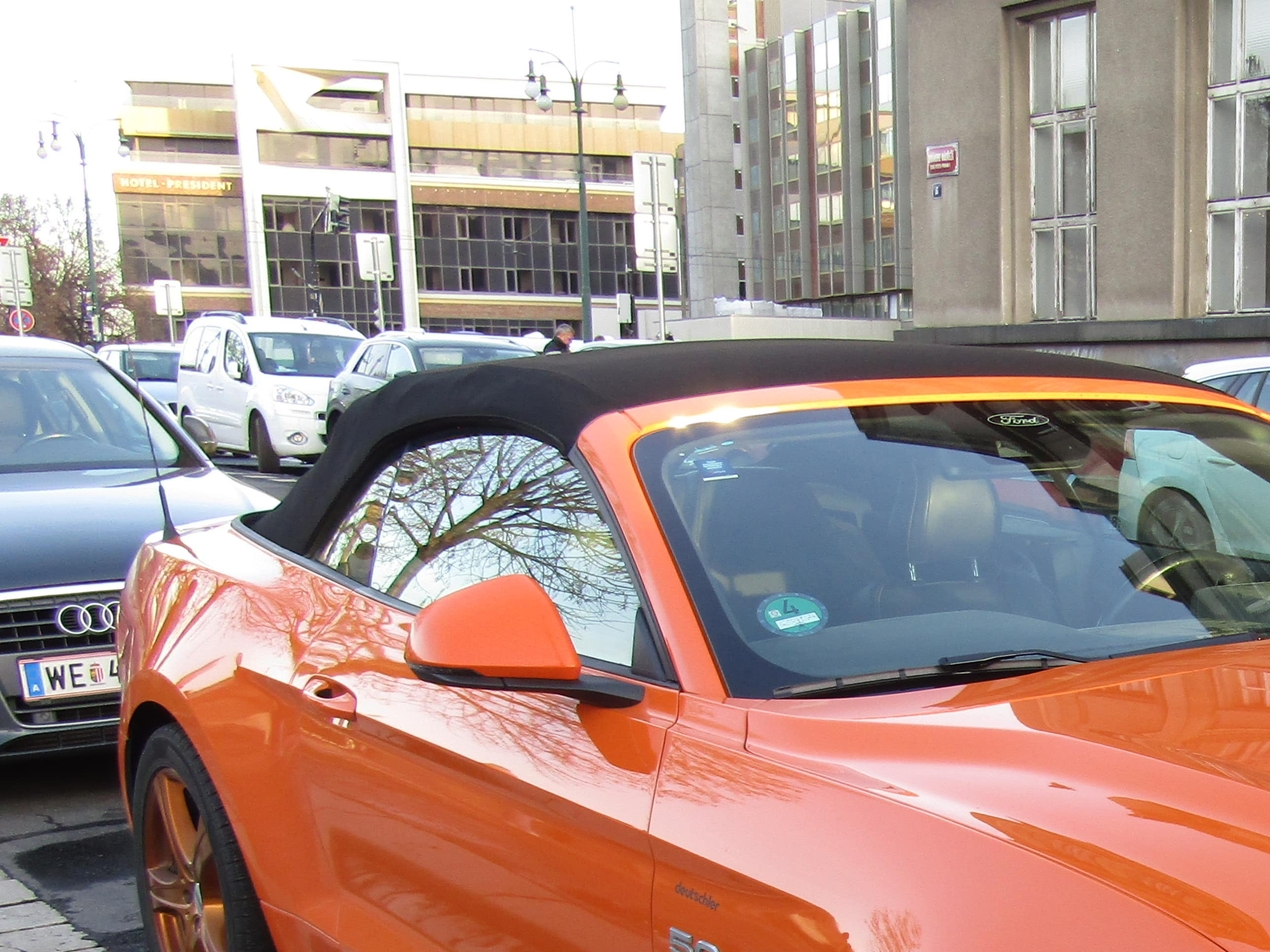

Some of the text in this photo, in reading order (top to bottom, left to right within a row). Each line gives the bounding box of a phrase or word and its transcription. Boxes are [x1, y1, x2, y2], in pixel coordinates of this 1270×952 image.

[120, 177, 233, 191] HOTEL PRESIDENT
[1000, 414, 1040, 425] Ford
[783, 599, 800, 614] 4
[45, 662, 87, 691] WE
[32, 684, 41, 693] A
[674, 881, 721, 912] deutschler
